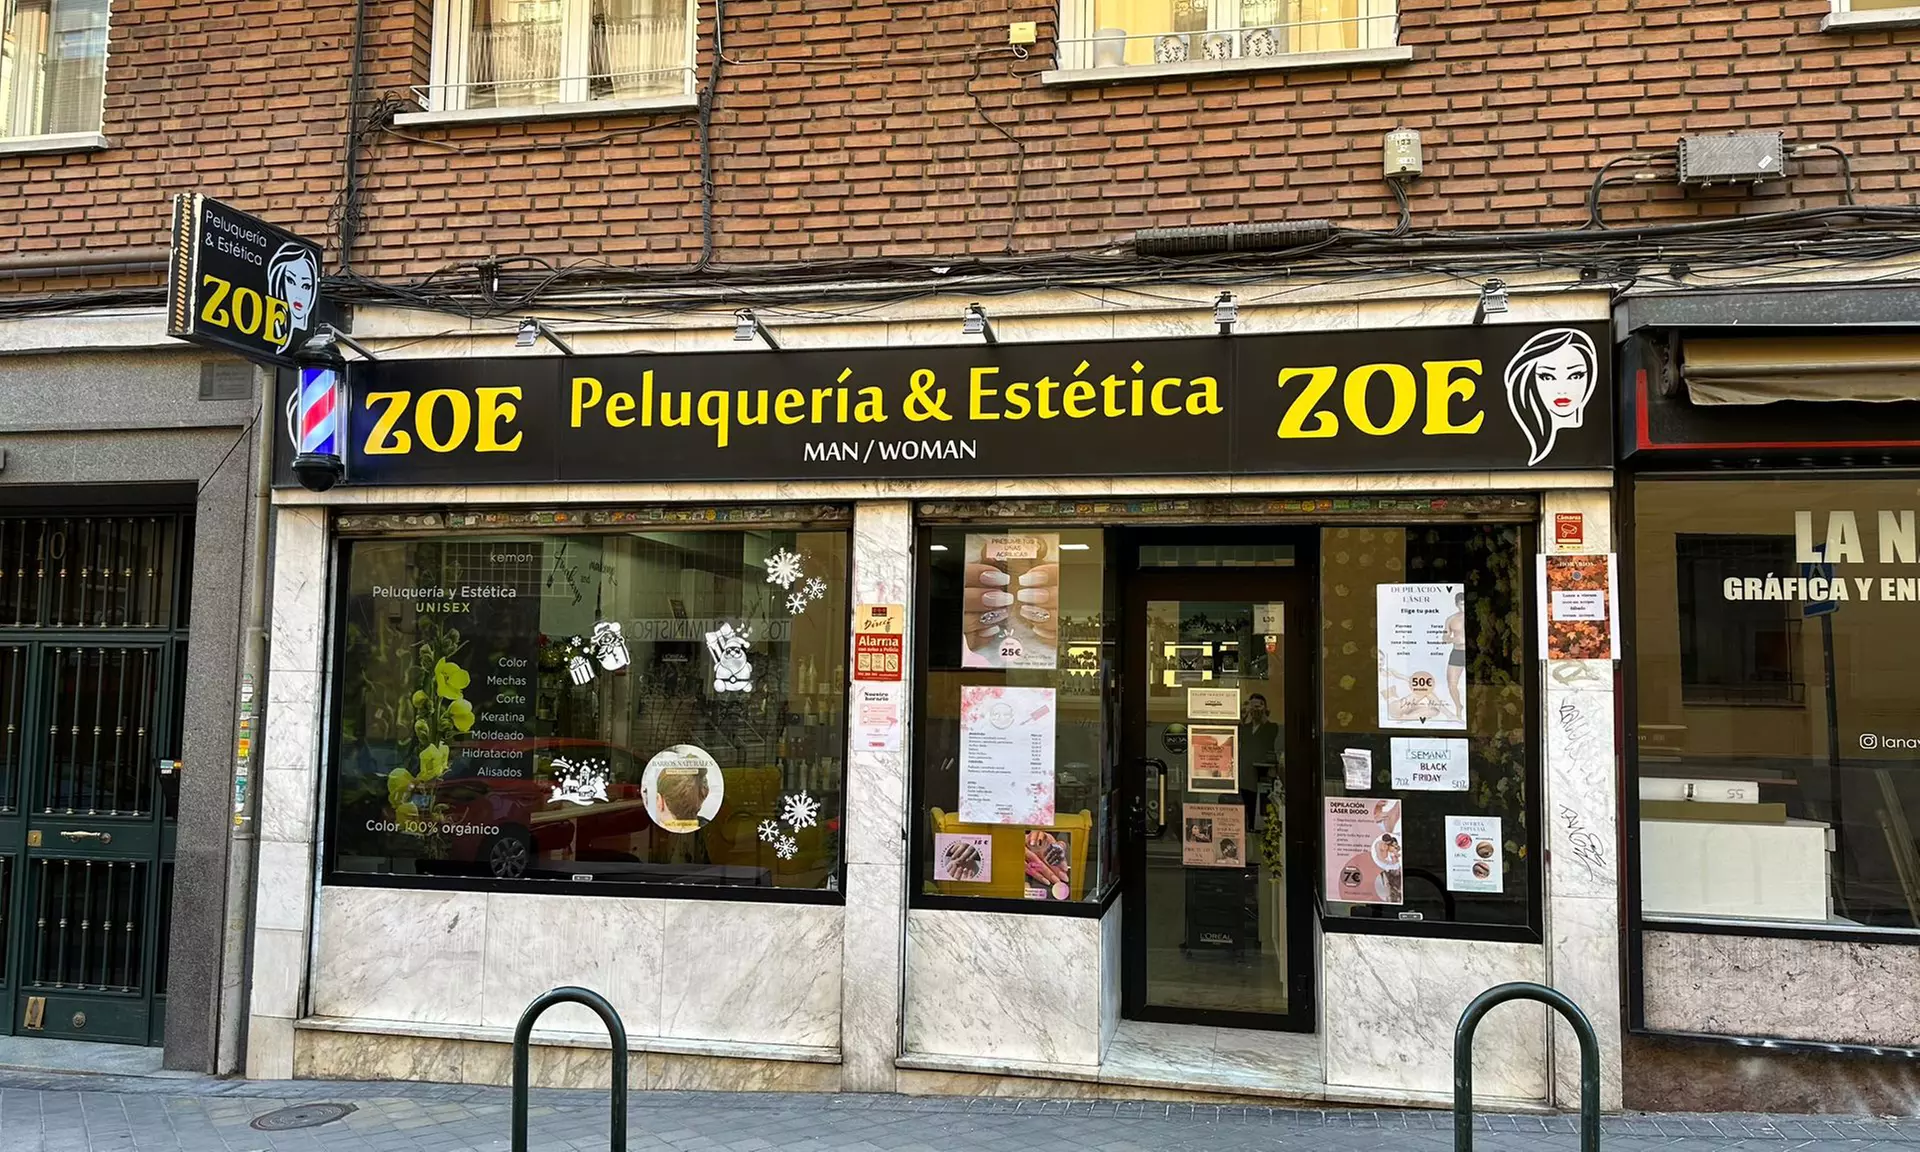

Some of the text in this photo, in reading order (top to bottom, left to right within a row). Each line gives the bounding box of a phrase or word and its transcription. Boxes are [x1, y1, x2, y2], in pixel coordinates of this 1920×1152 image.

[205, 210, 268, 248] Peluquería
[205, 232, 263, 267] & Estética
[200, 274, 289, 347] ZOE
[570, 360, 1224, 448] Peluquería & Estética
[1277, 359, 1485, 439] ZOE
[363, 386, 524, 456] ZOE
[1795, 510, 1920, 564] LA N
[490, 551, 534, 563] kemon
[1723, 572, 1920, 602] GRÁFICA Y EN
[372, 586, 517, 601] Peluquería y Estética
[415, 602, 471, 613] UNISEX
[858, 635, 899, 647] Alarma
[498, 657, 529, 668] Color
[486, 675, 527, 686] Mechas
[1411, 677, 1433, 687] 50€
[495, 693, 526, 704] Corte
[481, 711, 525, 722] Keratina
[471, 730, 525, 741] Moldeado
[462, 748, 524, 760] Hidratación
[1410, 751, 1448, 760] SEMANA
[476, 766, 523, 778] Alisados
[1419, 762, 1448, 771] BLACK
[1412, 773, 1442, 783] FRIDAY
[1330, 801, 1366, 810] DEPILACIÓN
[366, 819, 500, 837] Color 100% orgánico
[1343, 871, 1361, 883] 7€
